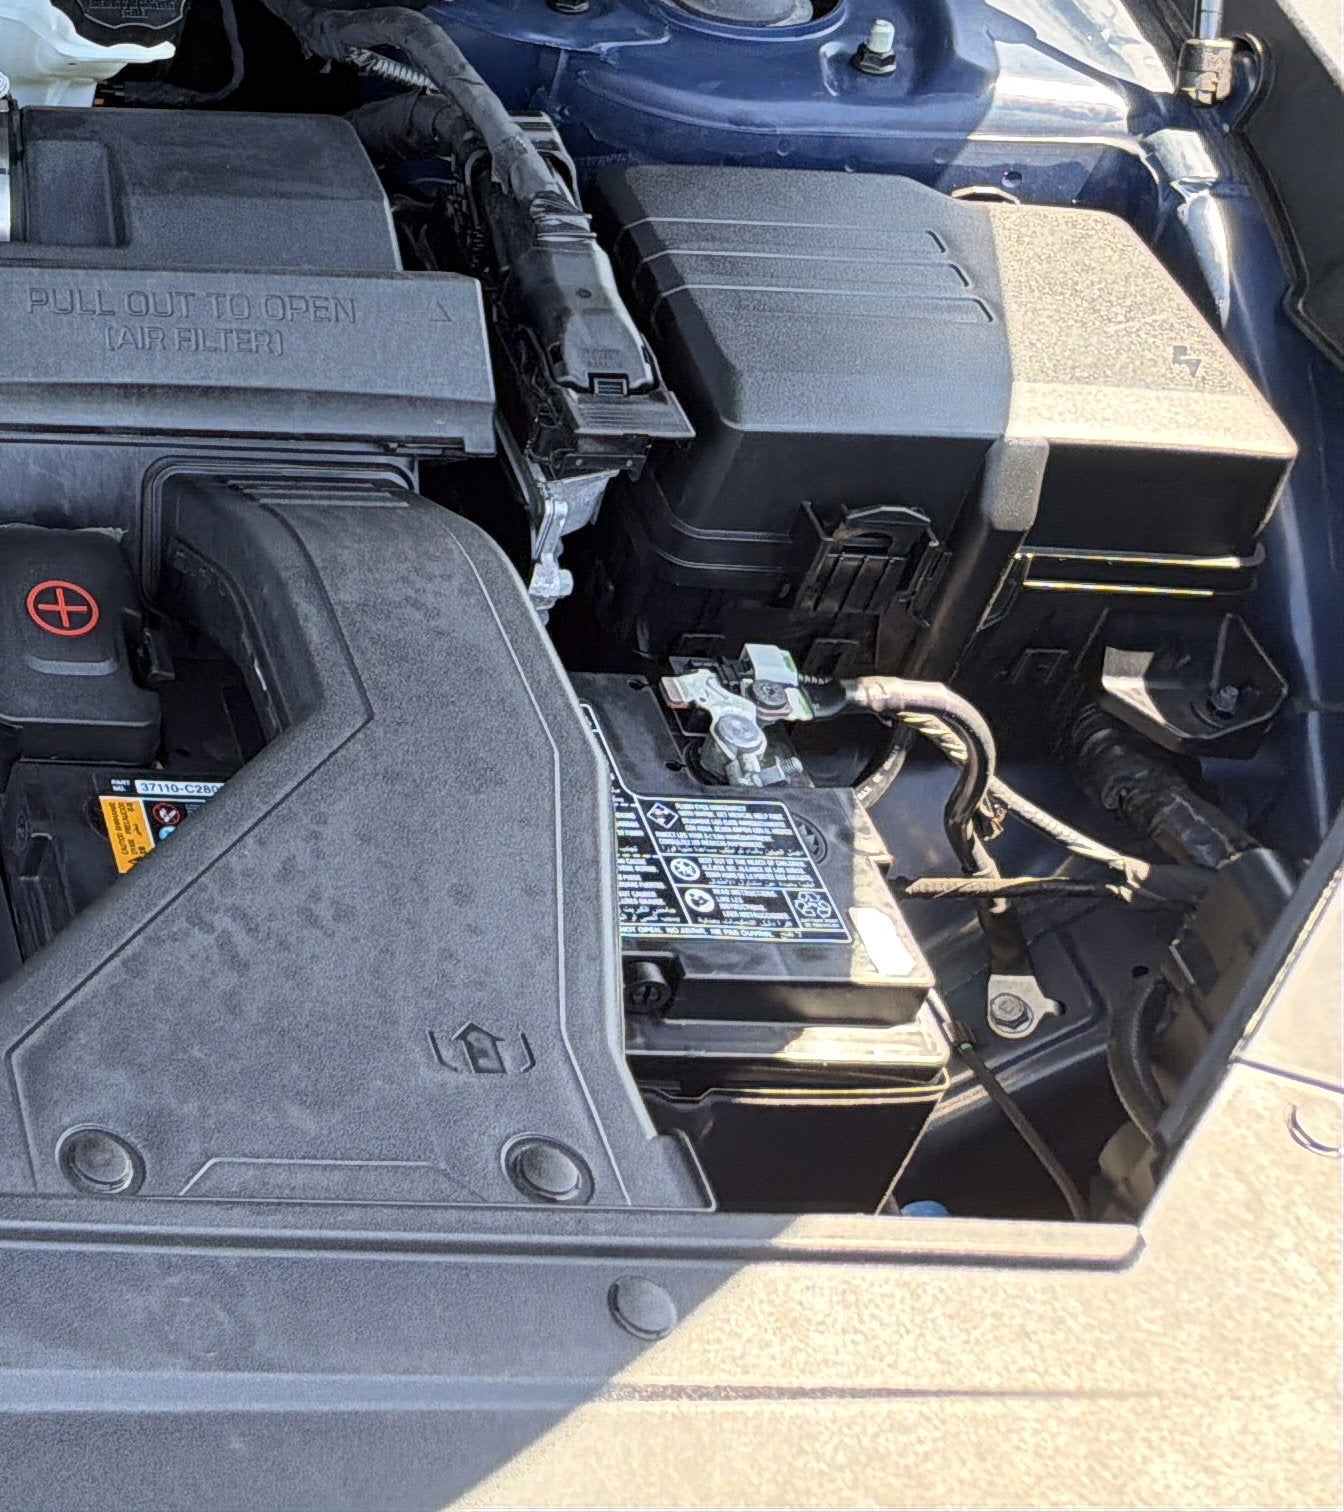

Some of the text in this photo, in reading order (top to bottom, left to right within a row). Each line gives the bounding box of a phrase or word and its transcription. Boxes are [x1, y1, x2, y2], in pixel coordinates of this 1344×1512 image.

[26, 286, 356, 324] PULL OUT TO OPEN
[105, 325, 284, 357] (AIR FILTER)
[140, 782, 224, 795] 37110-C280
